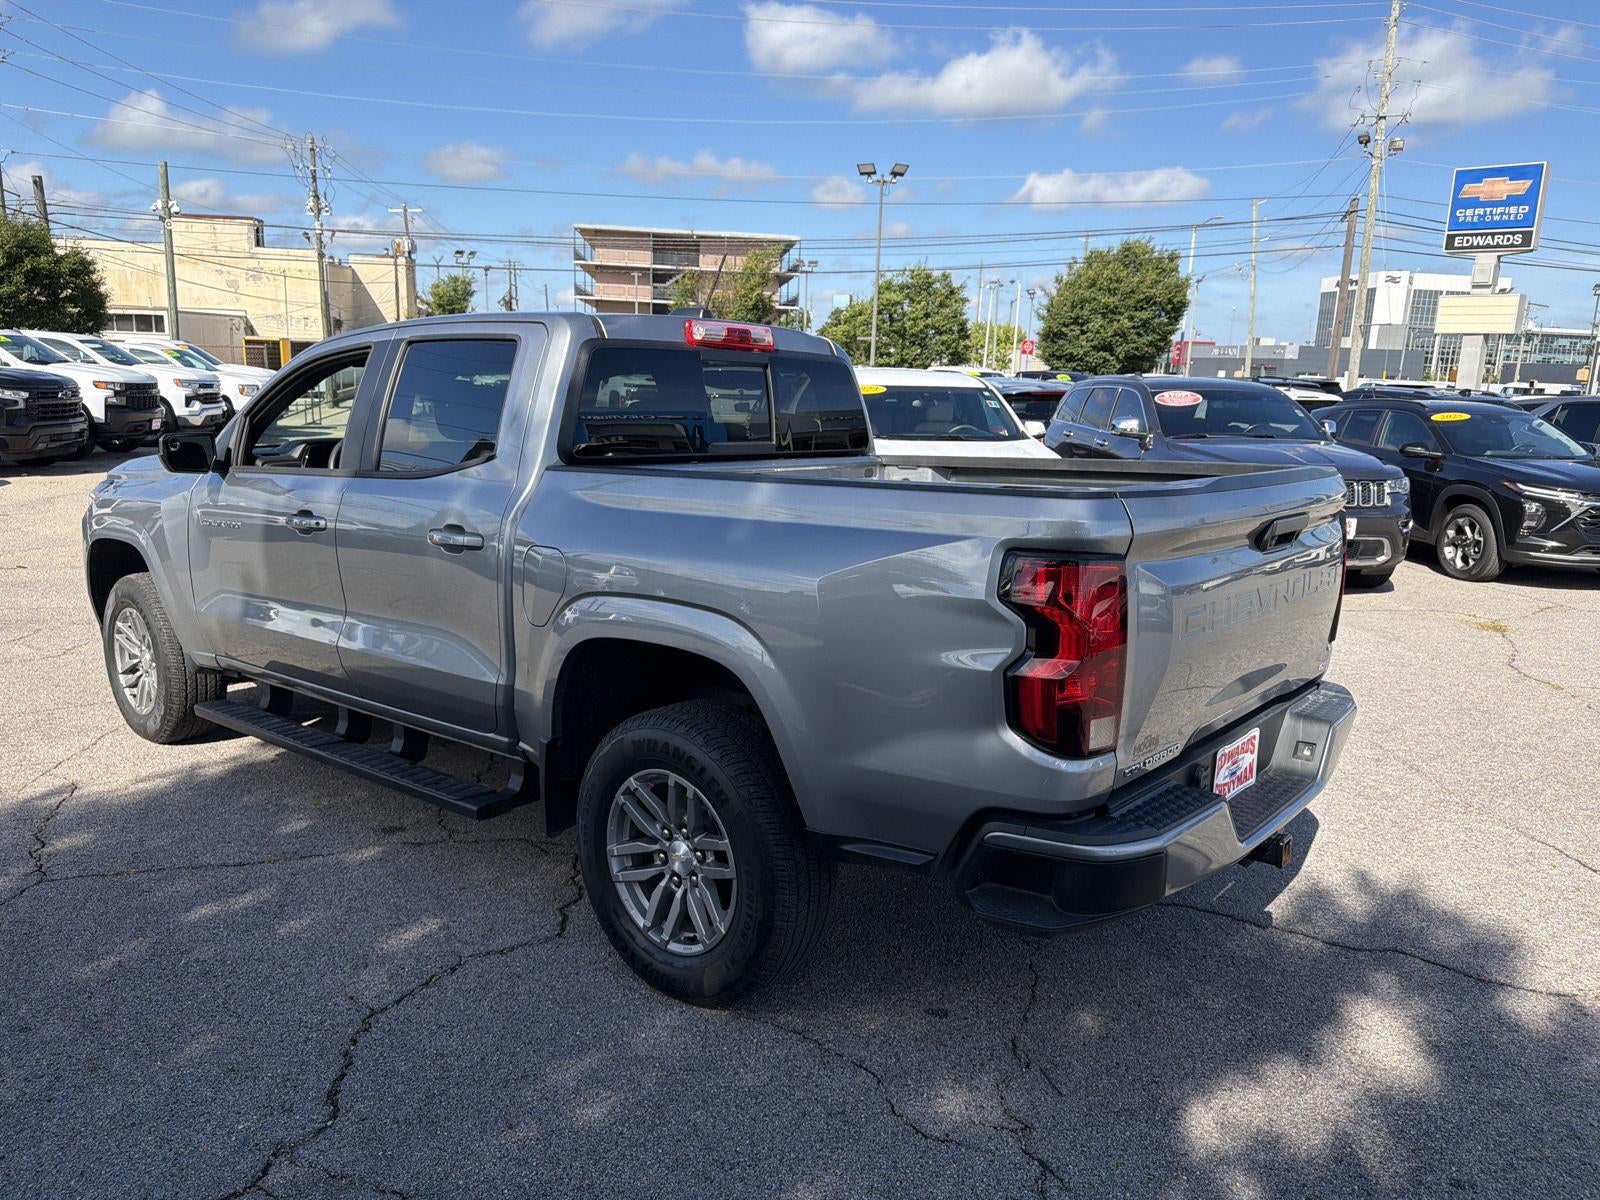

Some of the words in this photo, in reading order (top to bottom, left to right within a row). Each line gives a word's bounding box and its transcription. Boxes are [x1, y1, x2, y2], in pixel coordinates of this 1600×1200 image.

[1456, 205, 1529, 217] CERTIFIED
[1458, 213, 1524, 223] PRE-OWNED
[1454, 234, 1523, 247] EDWARDS
[1177, 564, 1340, 641] CHEVROLET
[631, 736, 731, 808] WRANGLER
[1122, 743, 1181, 778] COLORADO
[1217, 735, 1256, 775] EDWARDS
